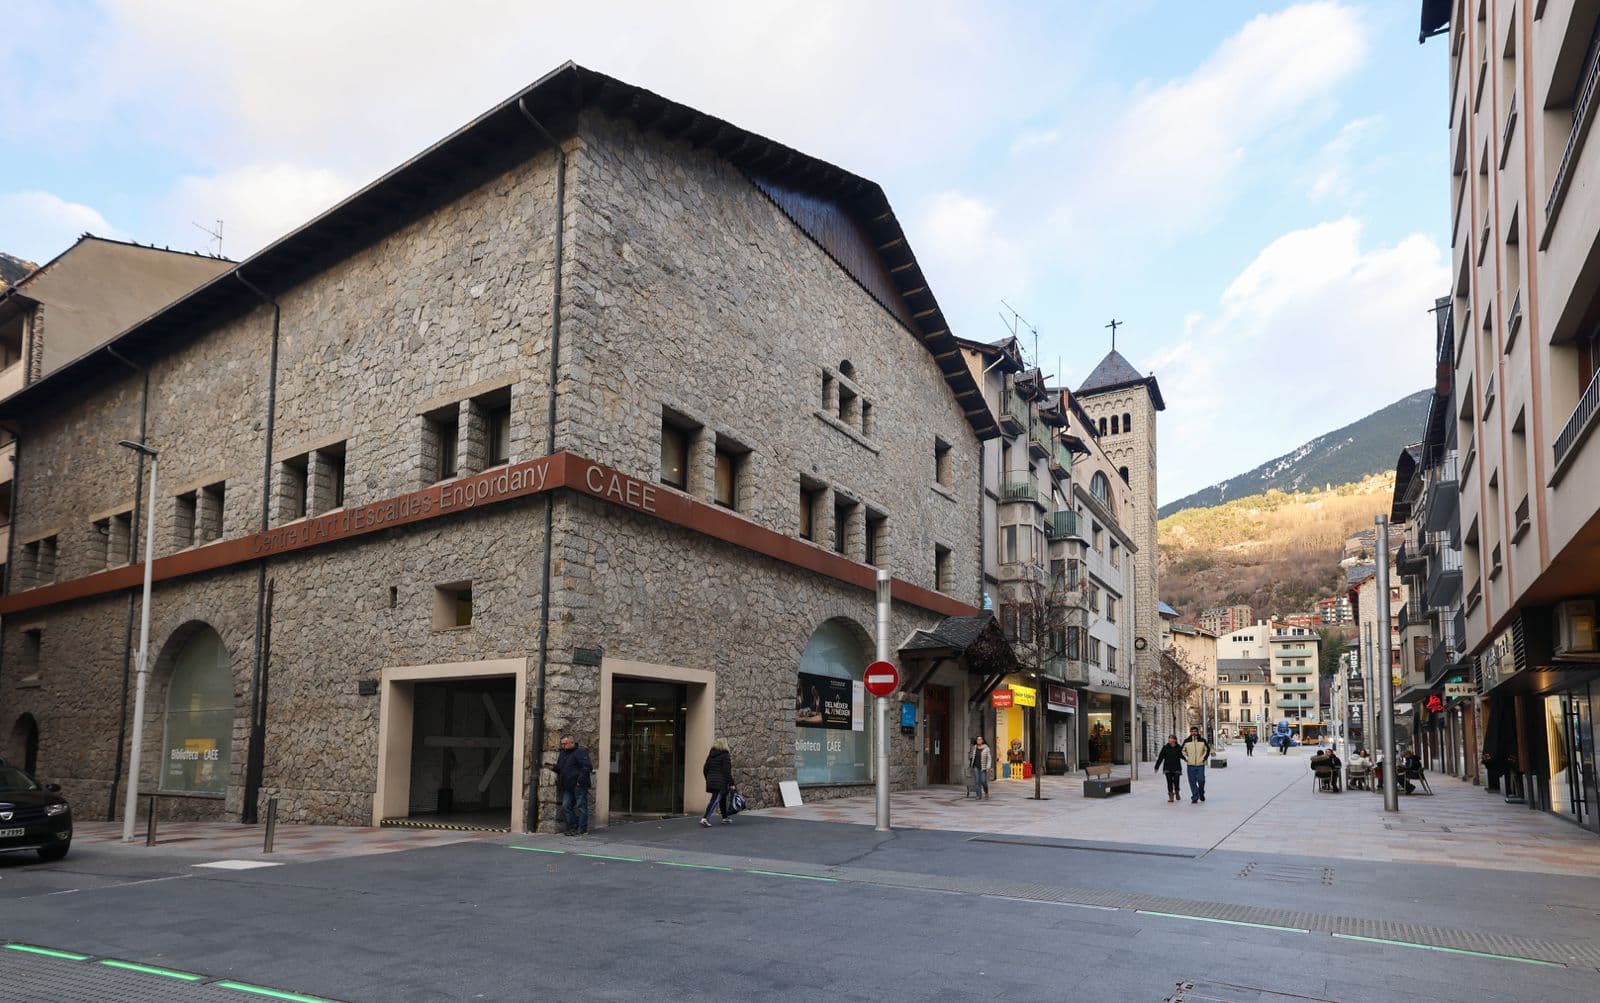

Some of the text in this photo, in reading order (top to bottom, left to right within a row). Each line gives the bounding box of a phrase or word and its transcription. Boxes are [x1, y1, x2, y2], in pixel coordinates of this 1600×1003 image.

[301, 517, 338, 542] d'Art
[342, 462, 550, 532] d'Escaldes-Engordany
[586, 465, 656, 513] CAEE
[171, 748, 219, 760] Biblioteca CAEE
[826, 740, 841, 752] CAEE
